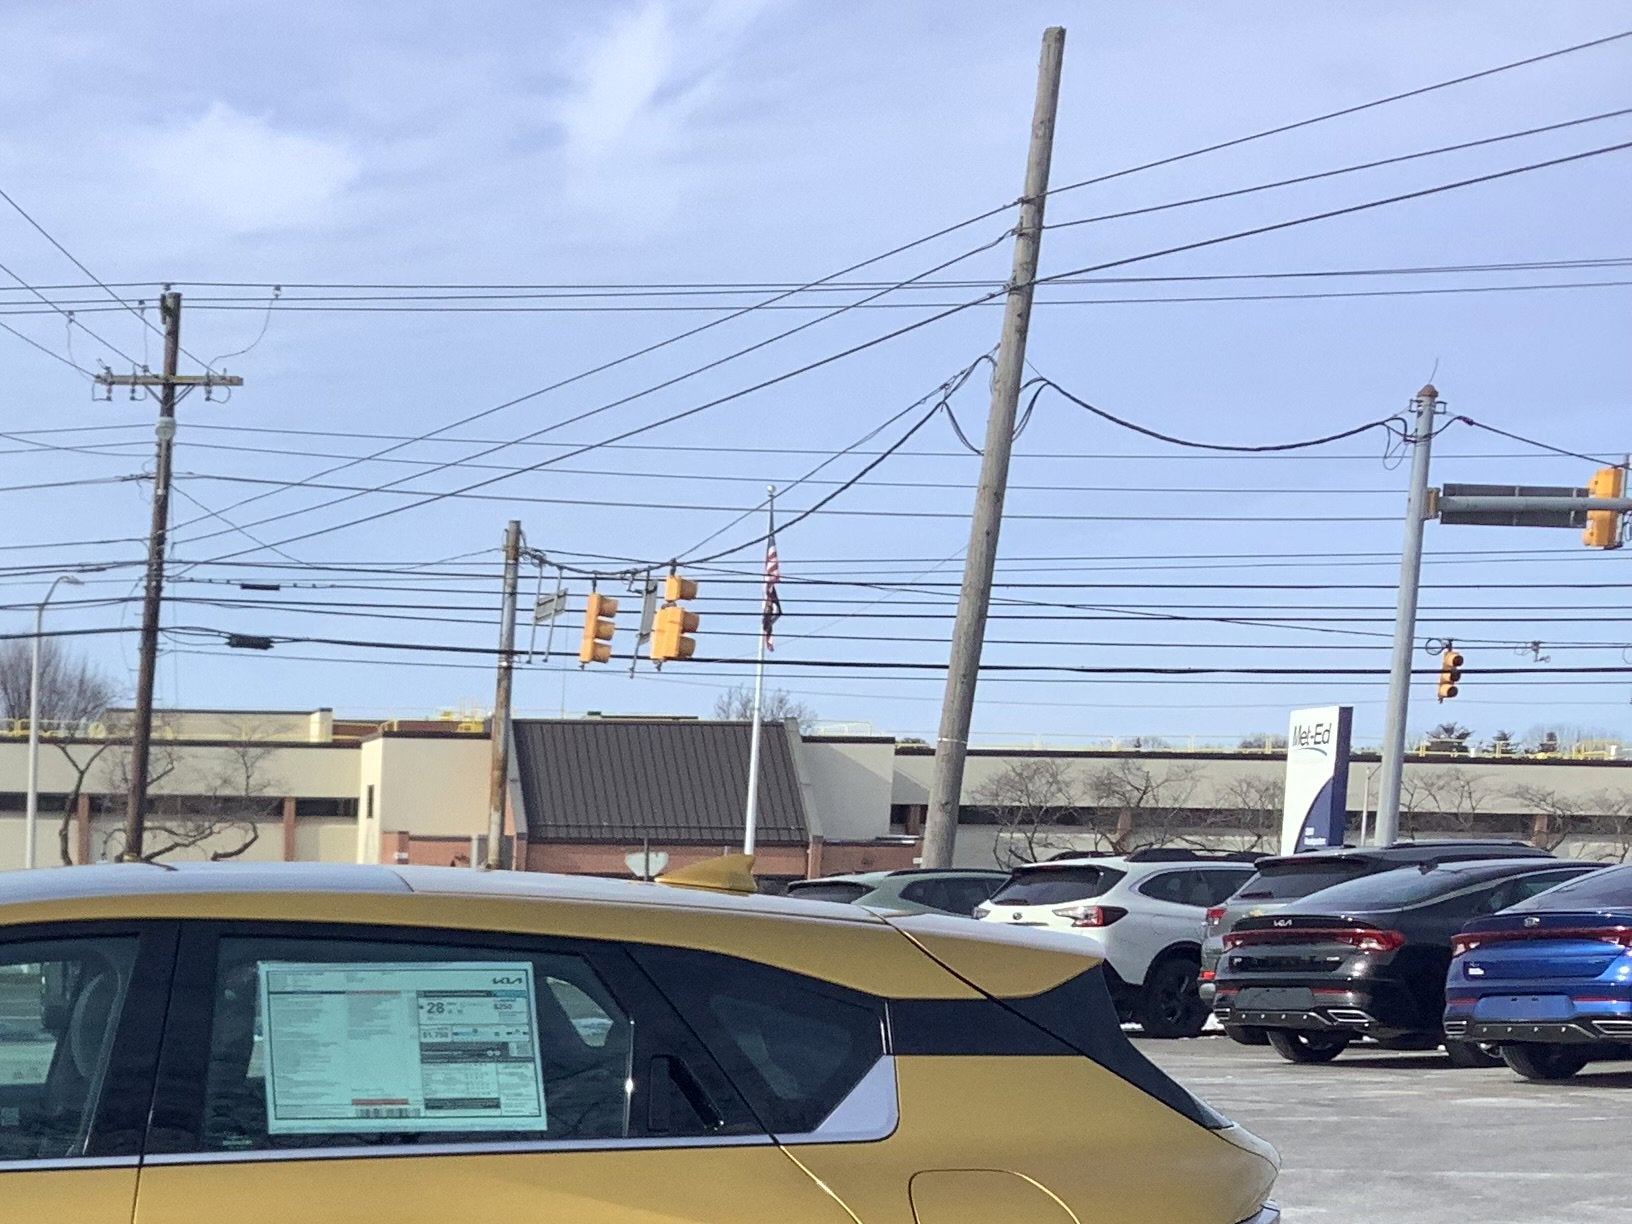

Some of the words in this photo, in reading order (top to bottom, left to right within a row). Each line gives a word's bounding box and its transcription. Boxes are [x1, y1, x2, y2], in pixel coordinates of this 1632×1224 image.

[1293, 722, 1332, 746] Met-Ed
[492, 977, 523, 985] KIA
[427, 1001, 445, 1014] 28
